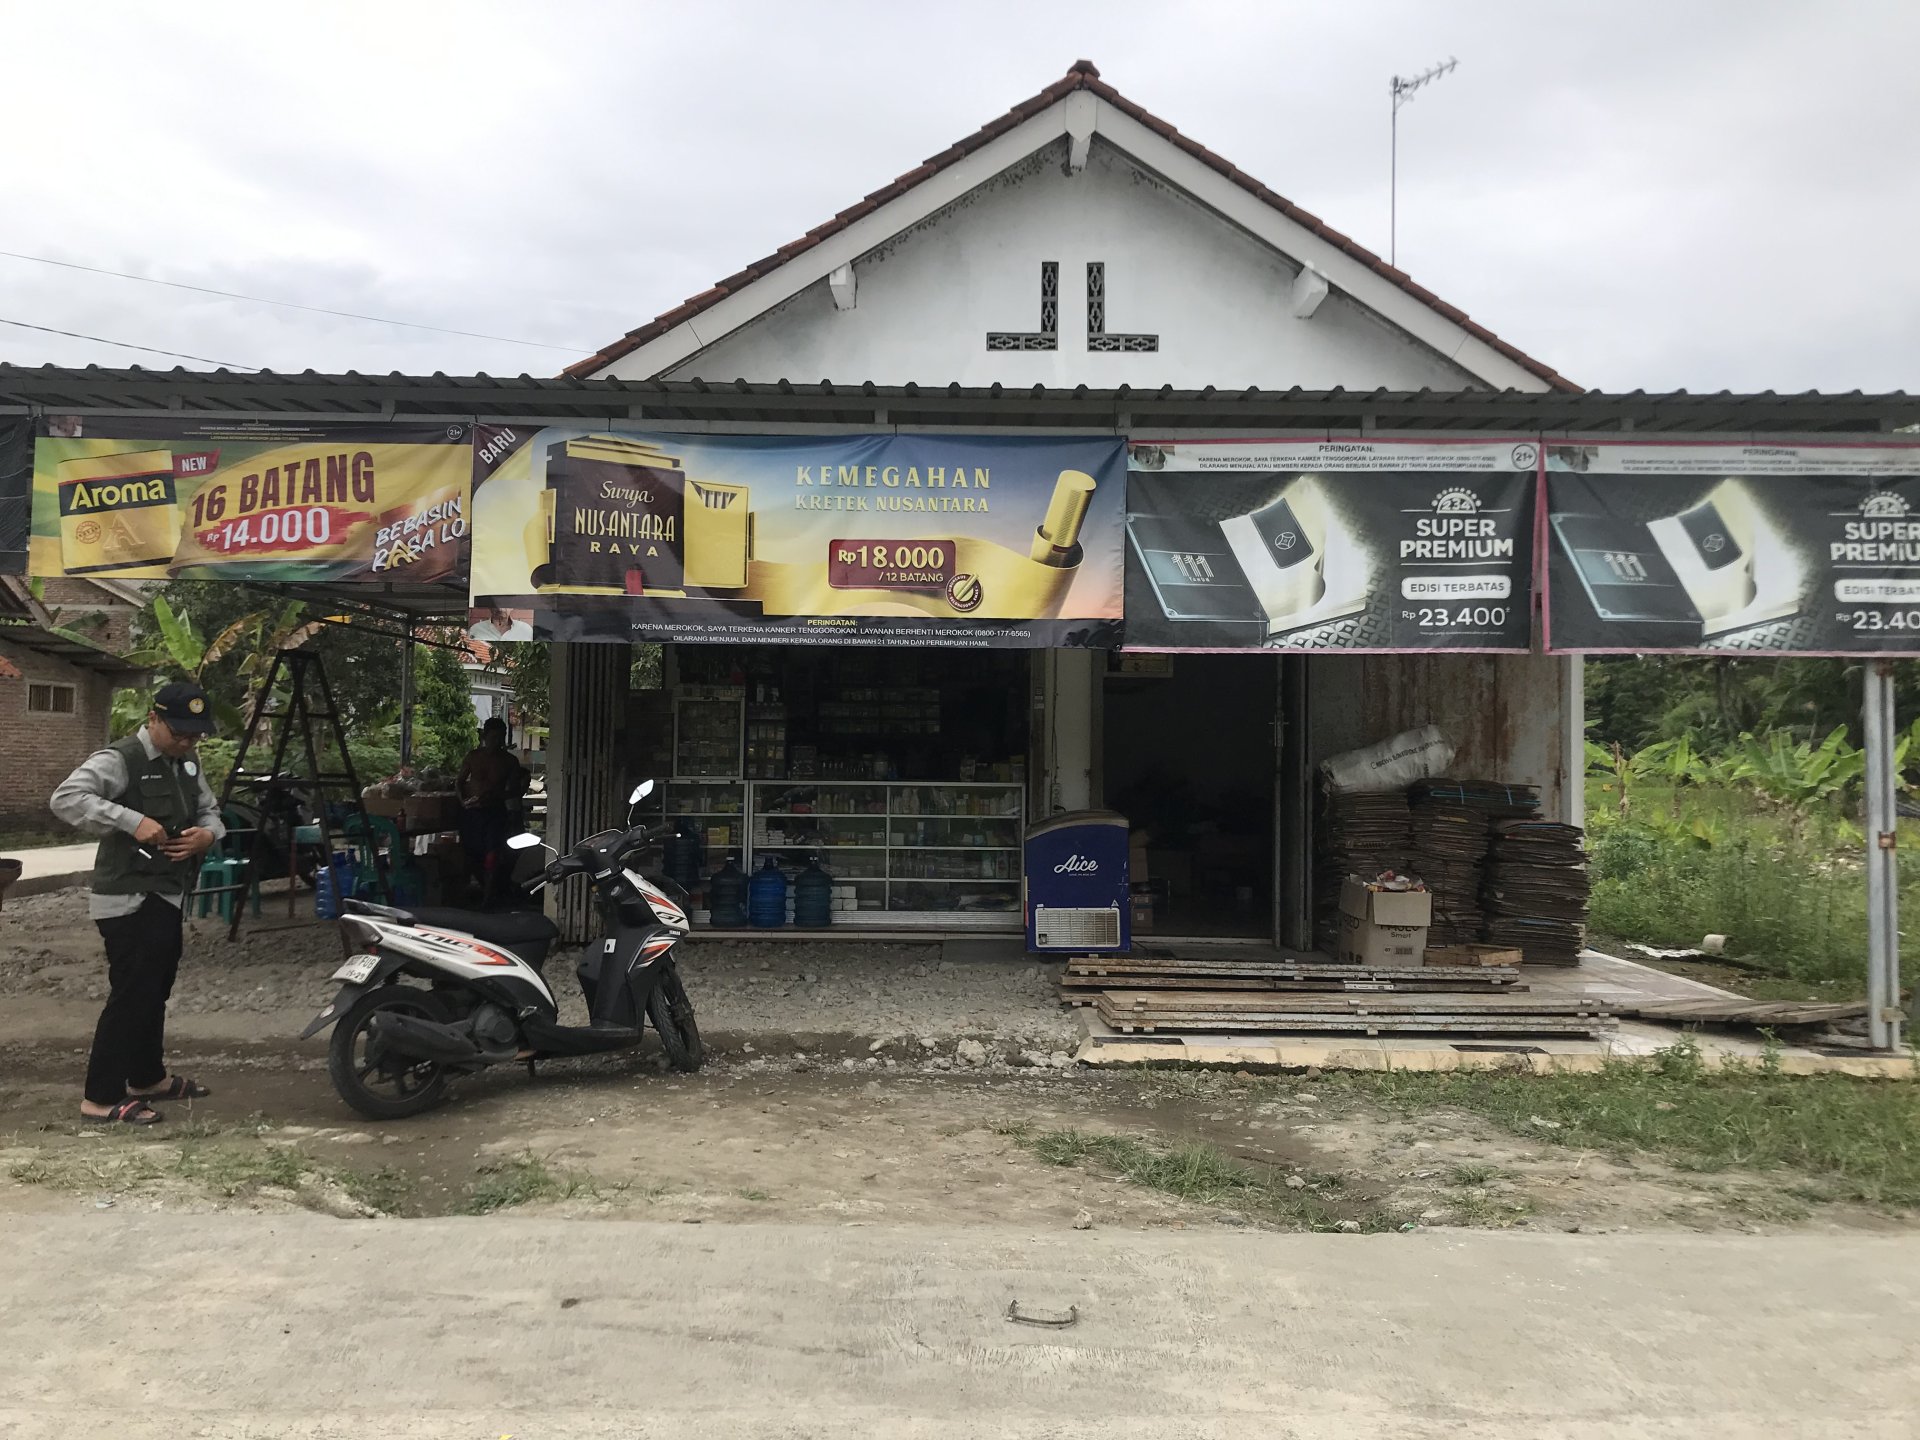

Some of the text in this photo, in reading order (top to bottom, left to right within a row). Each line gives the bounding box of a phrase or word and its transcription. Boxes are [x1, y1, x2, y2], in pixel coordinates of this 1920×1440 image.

[449, 427, 461, 437] 21+
[478, 427, 516, 464] BARU
[1318, 444, 1375, 453] PERINGATAN:
[181, 456, 207, 473] NEW
[1515, 452, 1533, 462] 21+
[796, 465, 991, 489] KEMEGAHAN
[69, 478, 167, 511] Aroma
[191, 451, 375, 528] 16 BATANG
[600, 480, 654, 509] Surya
[795, 494, 990, 512] KRETEK NUSANTARA
[1442, 498, 1471, 510] 234
[222, 507, 330, 550] 14.000
[375, 496, 462, 548] BEBASIN
[441, 518, 466, 543] LO
[575, 506, 675, 542] NUSANTARA
[1416, 519, 1497, 537] SUPER
[1844, 522, 1920, 540] SUPER
[590, 541, 659, 557] RAYA
[1400, 538, 1514, 558] PREMIUM
[900, 573, 944, 583] BATANG
[1410, 582, 1505, 593] EDISI TERBATAS
[807, 619, 858, 627] PERINGATAN:
[1402, 610, 1416, 620] Rp
[631, 623, 663, 631] KARENA
[664, 624, 706, 633] MEROKOK,
[707, 625, 727, 633] SAYA
[728, 625, 764, 633] TERKENA
[765, 626, 796, 634] KANKER
[895, 628, 934, 636] BERHENTI
[1053, 854, 1099, 874] Aice
